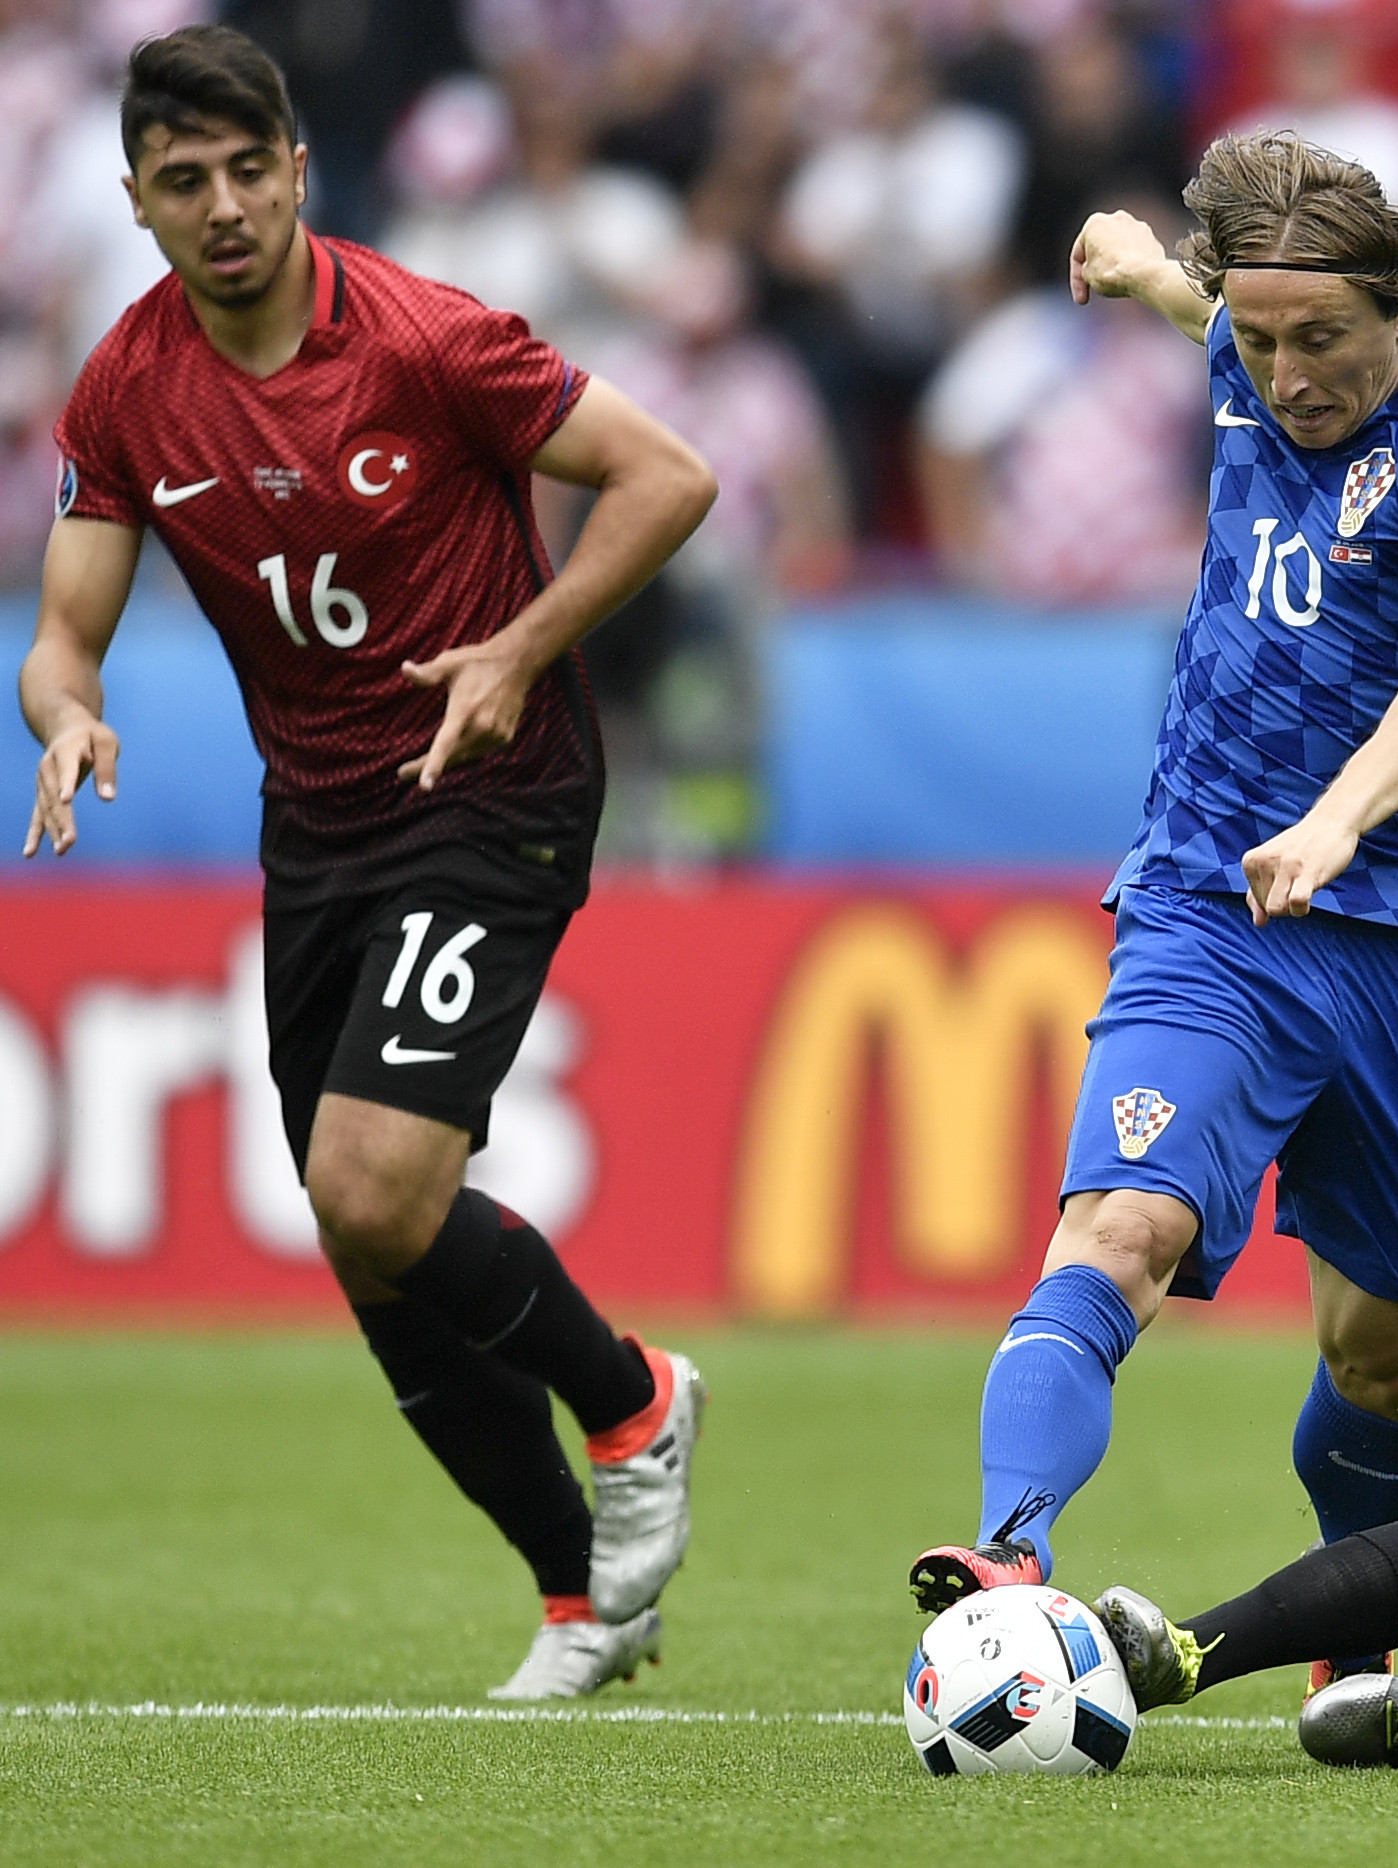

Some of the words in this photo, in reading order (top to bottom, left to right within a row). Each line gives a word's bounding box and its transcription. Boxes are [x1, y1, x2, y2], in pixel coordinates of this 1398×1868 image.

[257, 553, 369, 648] 16
[1244, 518, 1322, 627] 10
[382, 911, 488, 1024] 16
